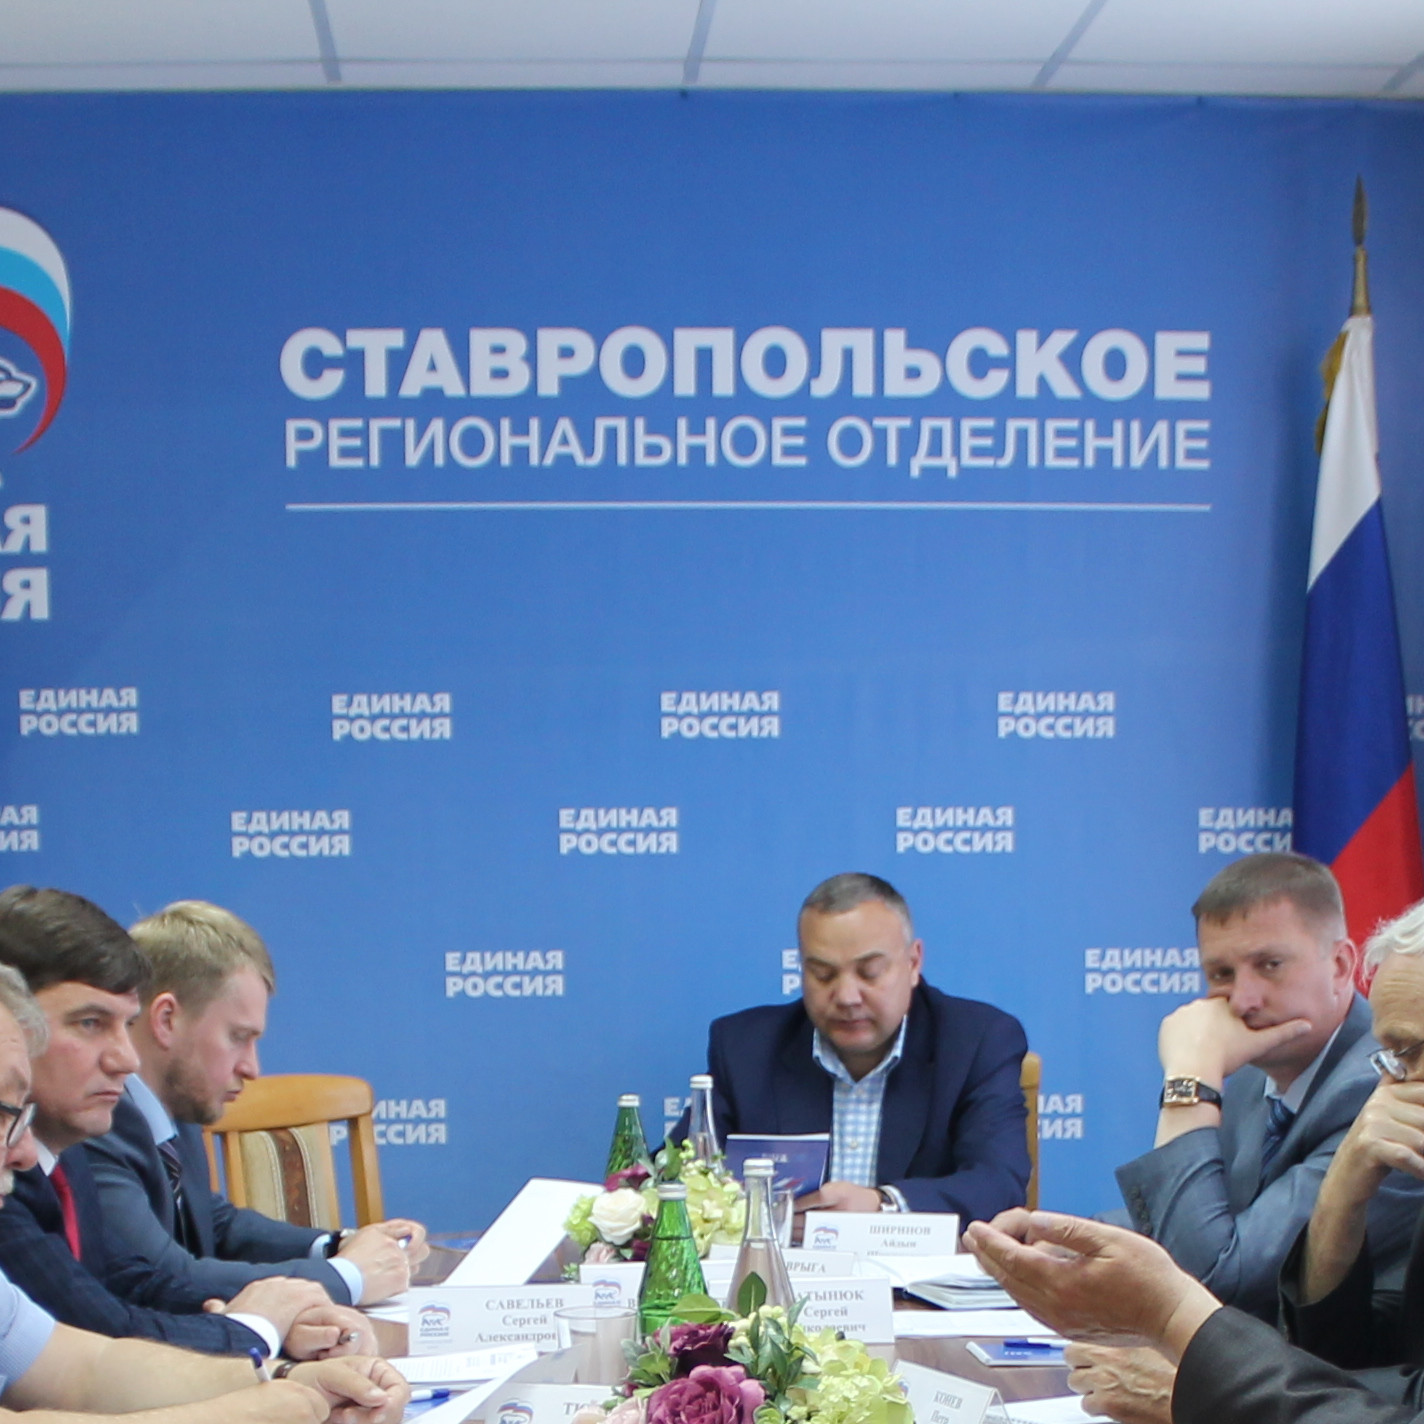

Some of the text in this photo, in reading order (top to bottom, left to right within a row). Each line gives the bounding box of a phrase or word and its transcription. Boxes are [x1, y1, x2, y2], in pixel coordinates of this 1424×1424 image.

[279, 326, 1211, 400] СТАВРОПОЛЬСКОЕ
[284, 416, 1211, 478] РЕГИОНАЛЬНОЕ ОТДЕЛЕНИЕ
[20, 687, 138, 712] ЕДИНАЯ
[332, 692, 451, 717] ЕДИНАЯ
[660, 690, 780, 715] ЕДИНАЯ
[997, 691, 1115, 715] ЕДИНАЯ
[20, 711, 139, 736] РОССИЯ
[332, 716, 452, 741] РОССИЯ
[660, 715, 780, 738] РОССИЯ
[997, 715, 1115, 738] РОССИЯ
[231, 810, 351, 834] ЕДИНАЯ
[559, 807, 678, 831] ЕДИНАЯ
[896, 807, 1014, 829] ЕДИНАЯ
[1198, 807, 1293, 830] ЕДИНА
[231, 834, 351, 858] РОССИЯ
[559, 831, 679, 855] РОССИЯ
[896, 830, 1014, 853] РОССИЯ
[1198, 831, 1291, 854] РОССИ
[445, 949, 564, 974] ЕДИНАЯ
[1085, 947, 1202, 971] ЕДИНАЯ
[445, 974, 564, 998] РОССИЯ
[1085, 971, 1201, 994] РОССИЯ
[372, 1098, 446, 1119] ИНАЯ
[329, 1123, 446, 1146] РССИЯ
[485, 1298, 564, 1311] САВЕЛЬЕВ
[502, 1315, 548, 1328] Сергей
